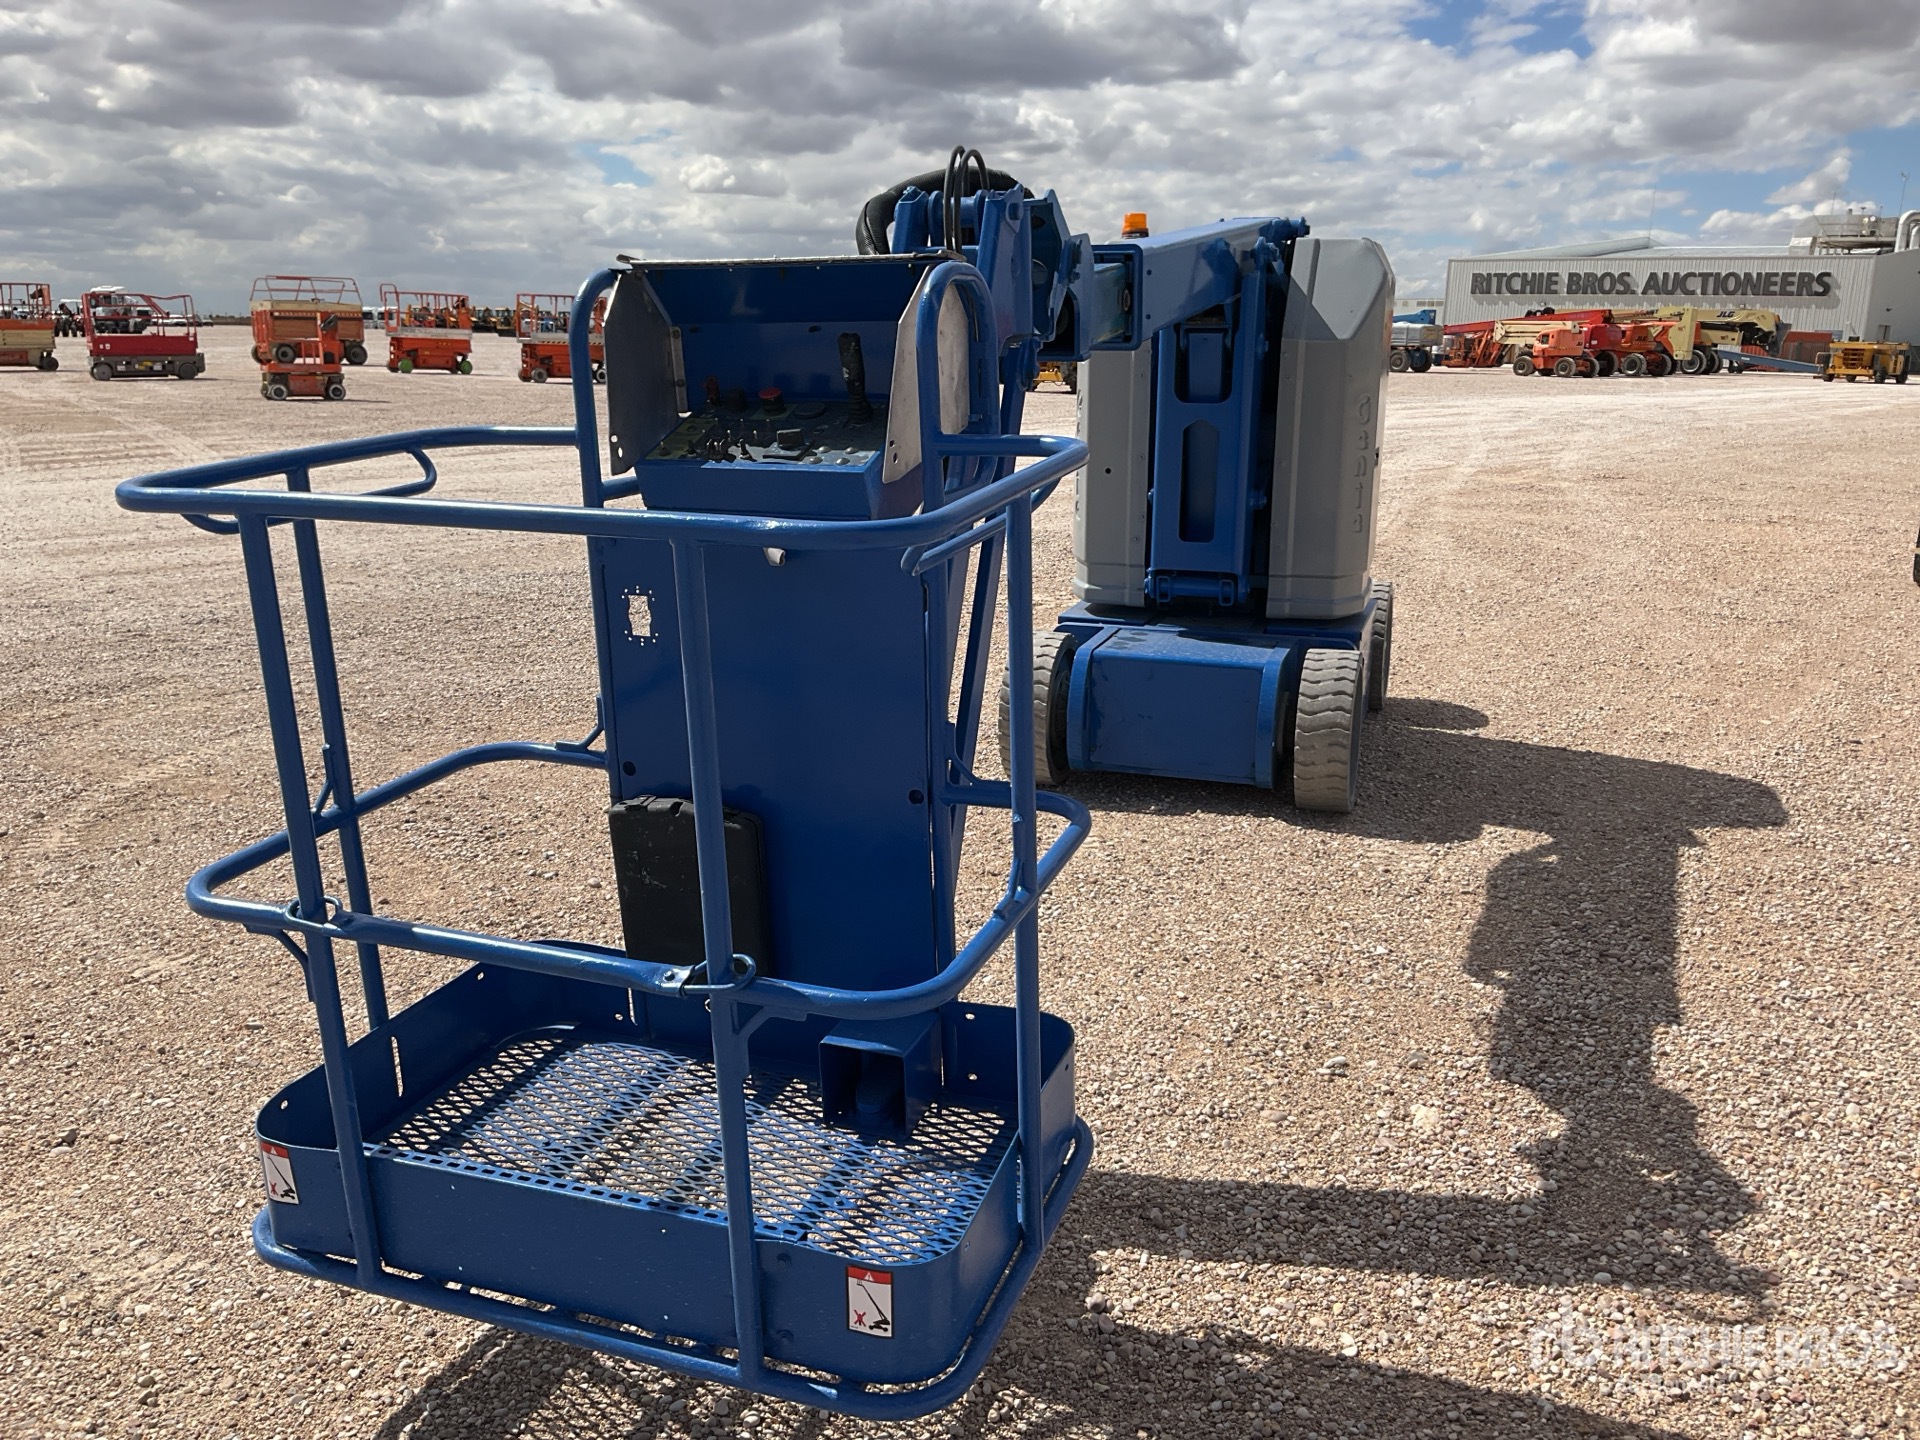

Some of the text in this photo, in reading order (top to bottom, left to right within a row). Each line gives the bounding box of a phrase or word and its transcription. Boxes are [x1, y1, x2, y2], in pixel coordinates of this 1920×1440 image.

[1471, 271, 1832, 296] RITCHIE BROS. AUCTIONEERS
[1716, 310, 1735, 318] JLG
